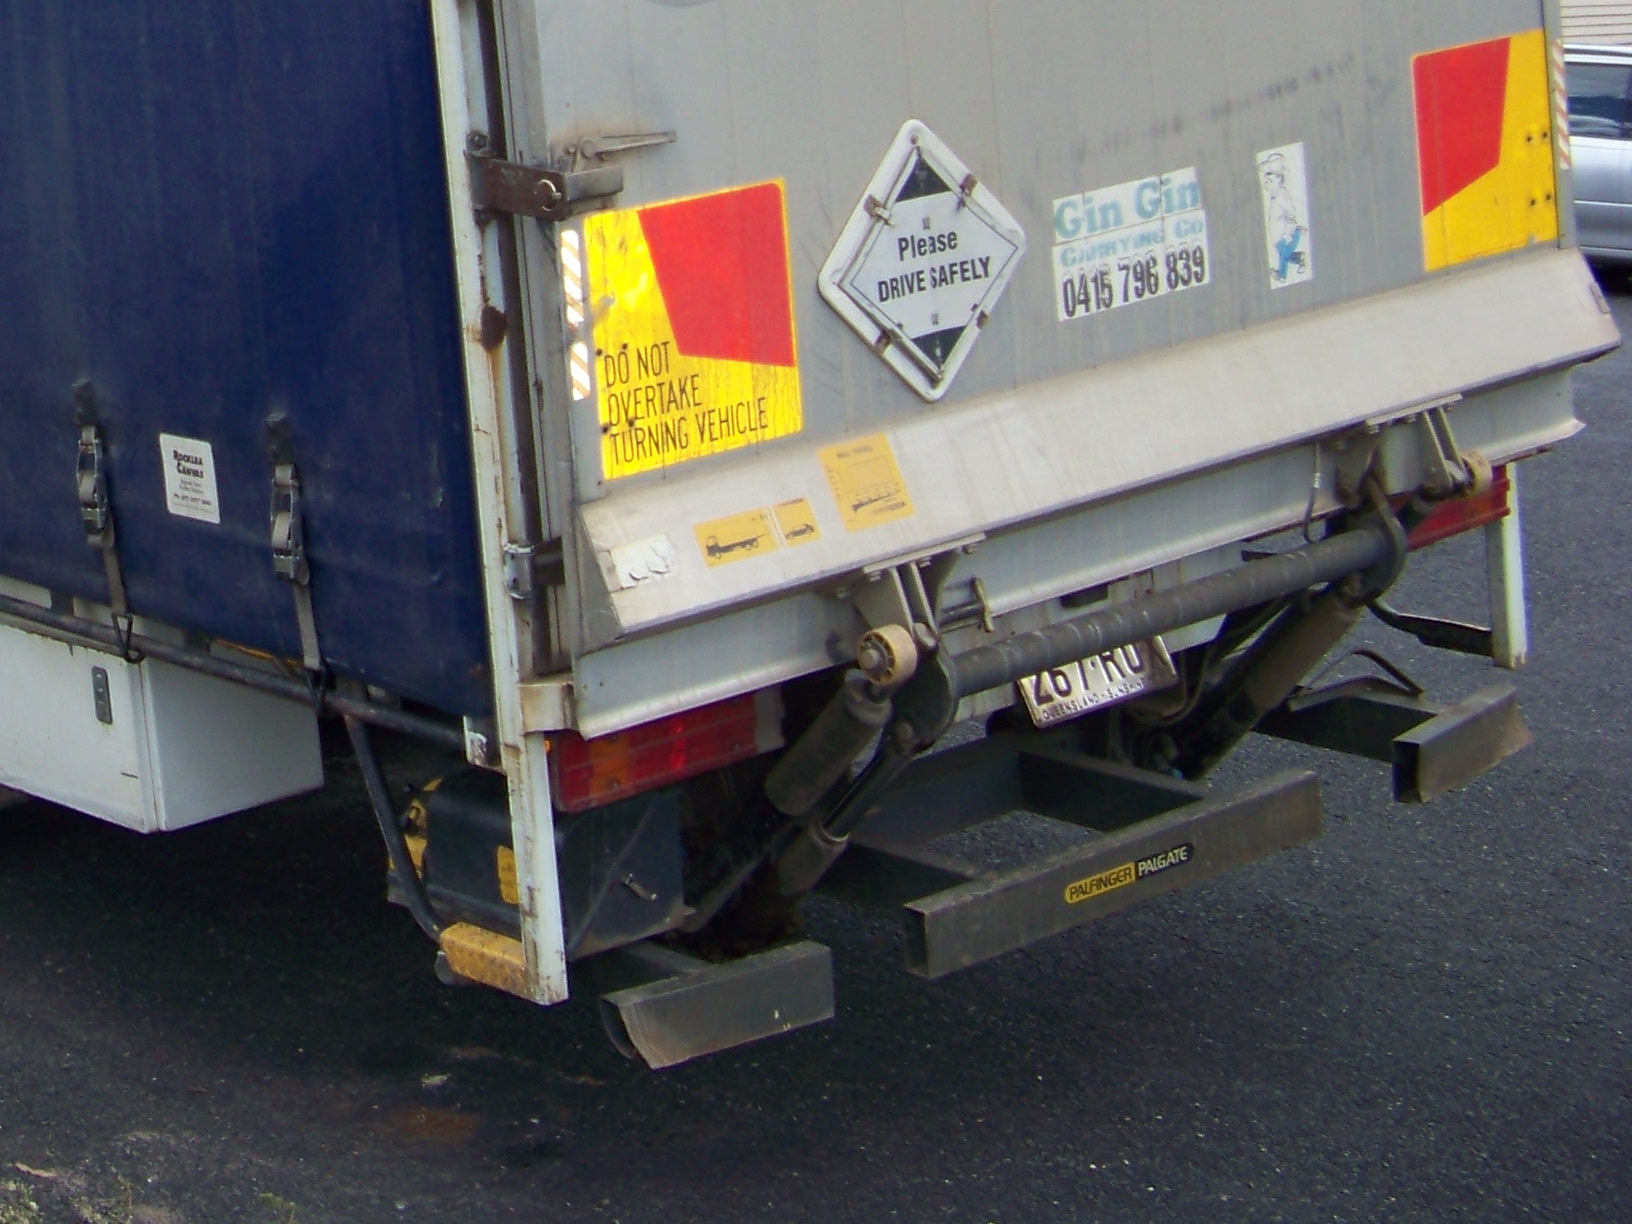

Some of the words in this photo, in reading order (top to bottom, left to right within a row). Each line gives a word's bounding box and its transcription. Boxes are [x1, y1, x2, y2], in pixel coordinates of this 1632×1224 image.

[1054, 196, 1124, 240] Gin
[1135, 177, 1201, 220] Gin
[897, 231, 958, 262] Please
[877, 269, 927, 303] DRIVE
[929, 256, 991, 289] SAFELY
[1062, 271, 1114, 318] 0415
[1118, 254, 1160, 303] 796
[1165, 244, 1206, 291] 839
[604, 351, 630, 388] DO
[636, 341, 670, 380] NOT
[607, 374, 703, 427] OVERTAKE
[609, 416, 689, 466] TURNING
[694, 397, 769, 444] VEHICLE
[1068, 866, 1133, 901] PALFINGER
[1137, 845, 1189, 877] PALGATE
